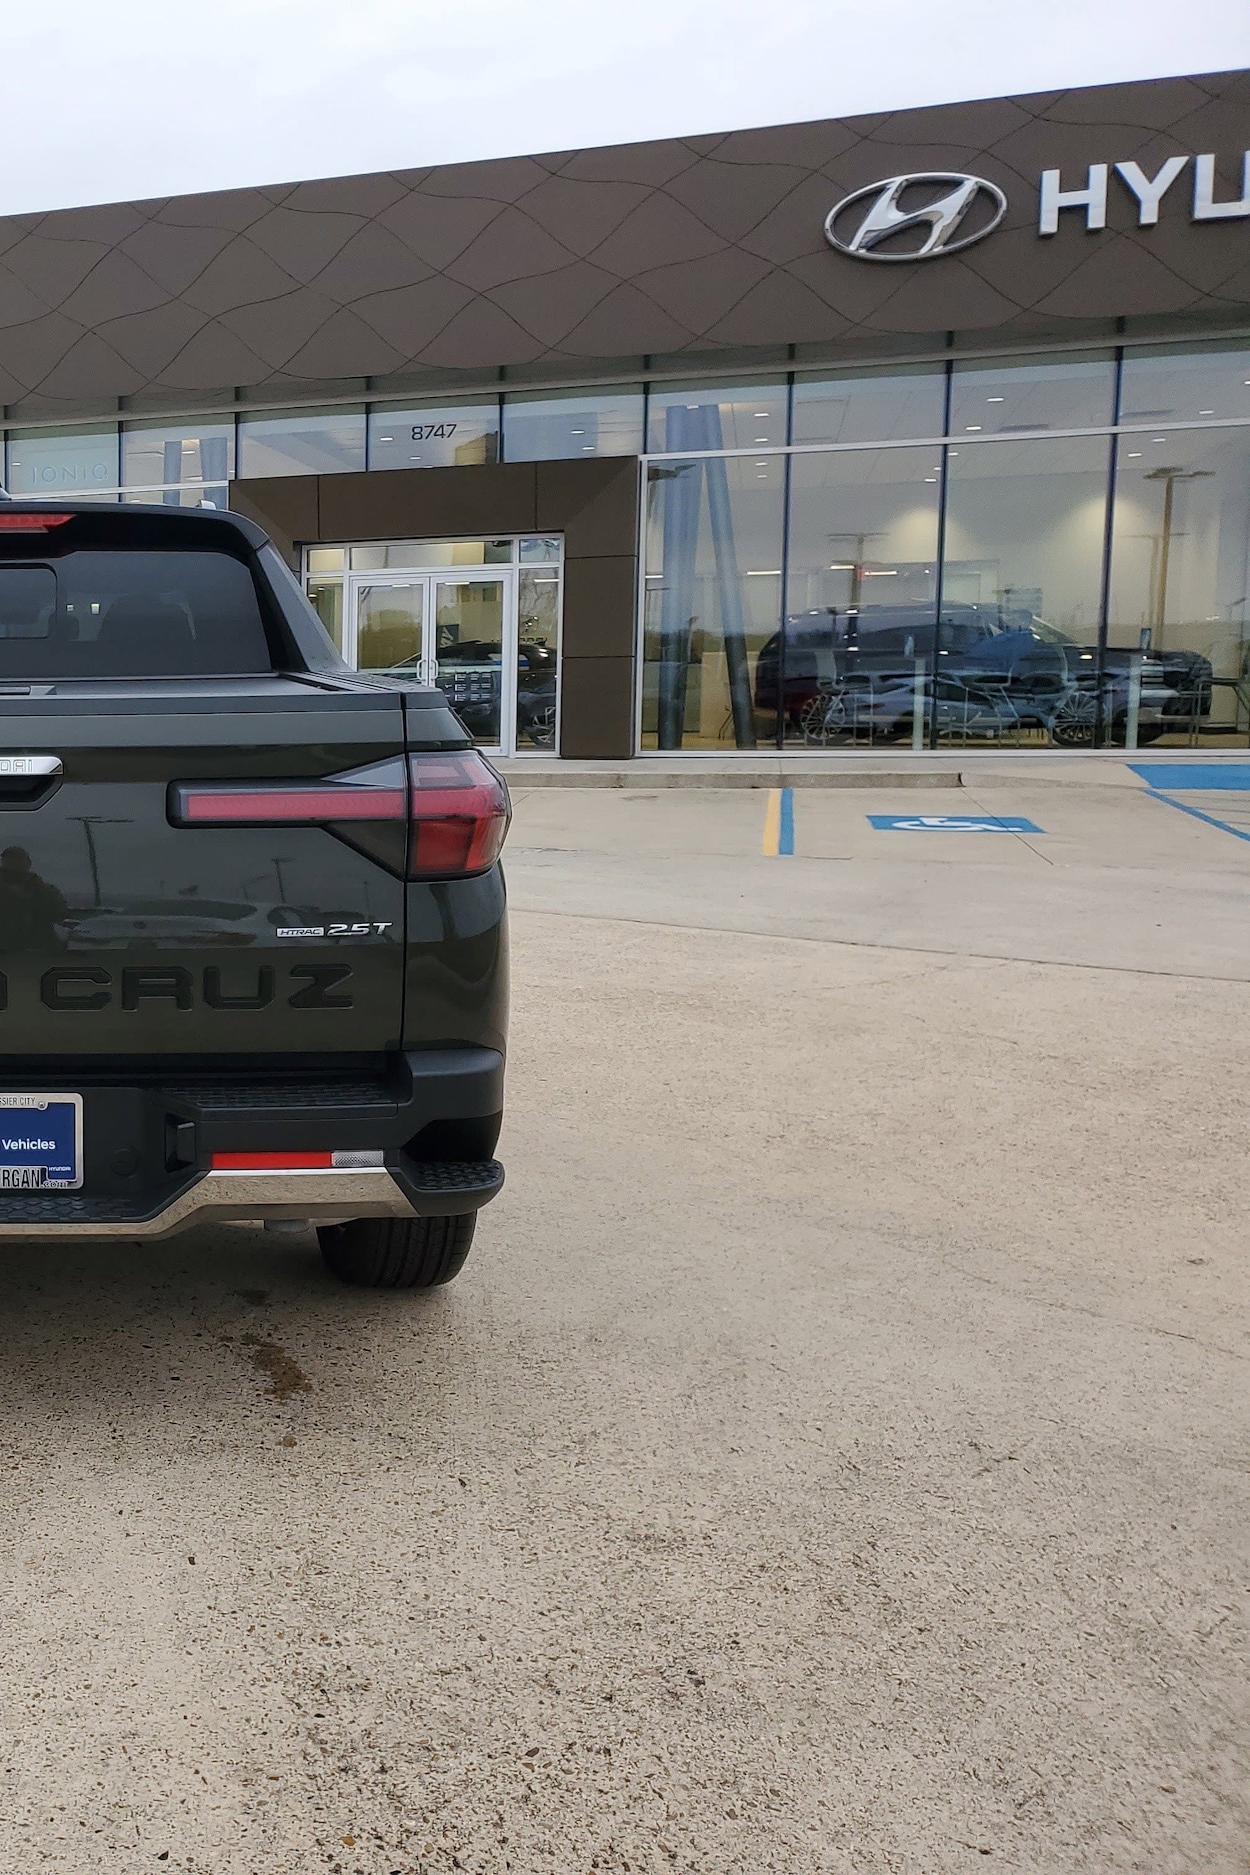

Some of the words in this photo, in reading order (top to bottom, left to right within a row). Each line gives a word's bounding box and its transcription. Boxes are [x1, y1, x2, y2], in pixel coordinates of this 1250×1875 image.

[411, 423, 457, 441] 8747
[32, 463, 108, 484] IONIQ
[279, 928, 323, 936] HTRAC
[40, 963, 355, 1012] CRUZ
[19, 1096, 36, 1106] CITY
[2, 1138, 56, 1151] Vehicles
